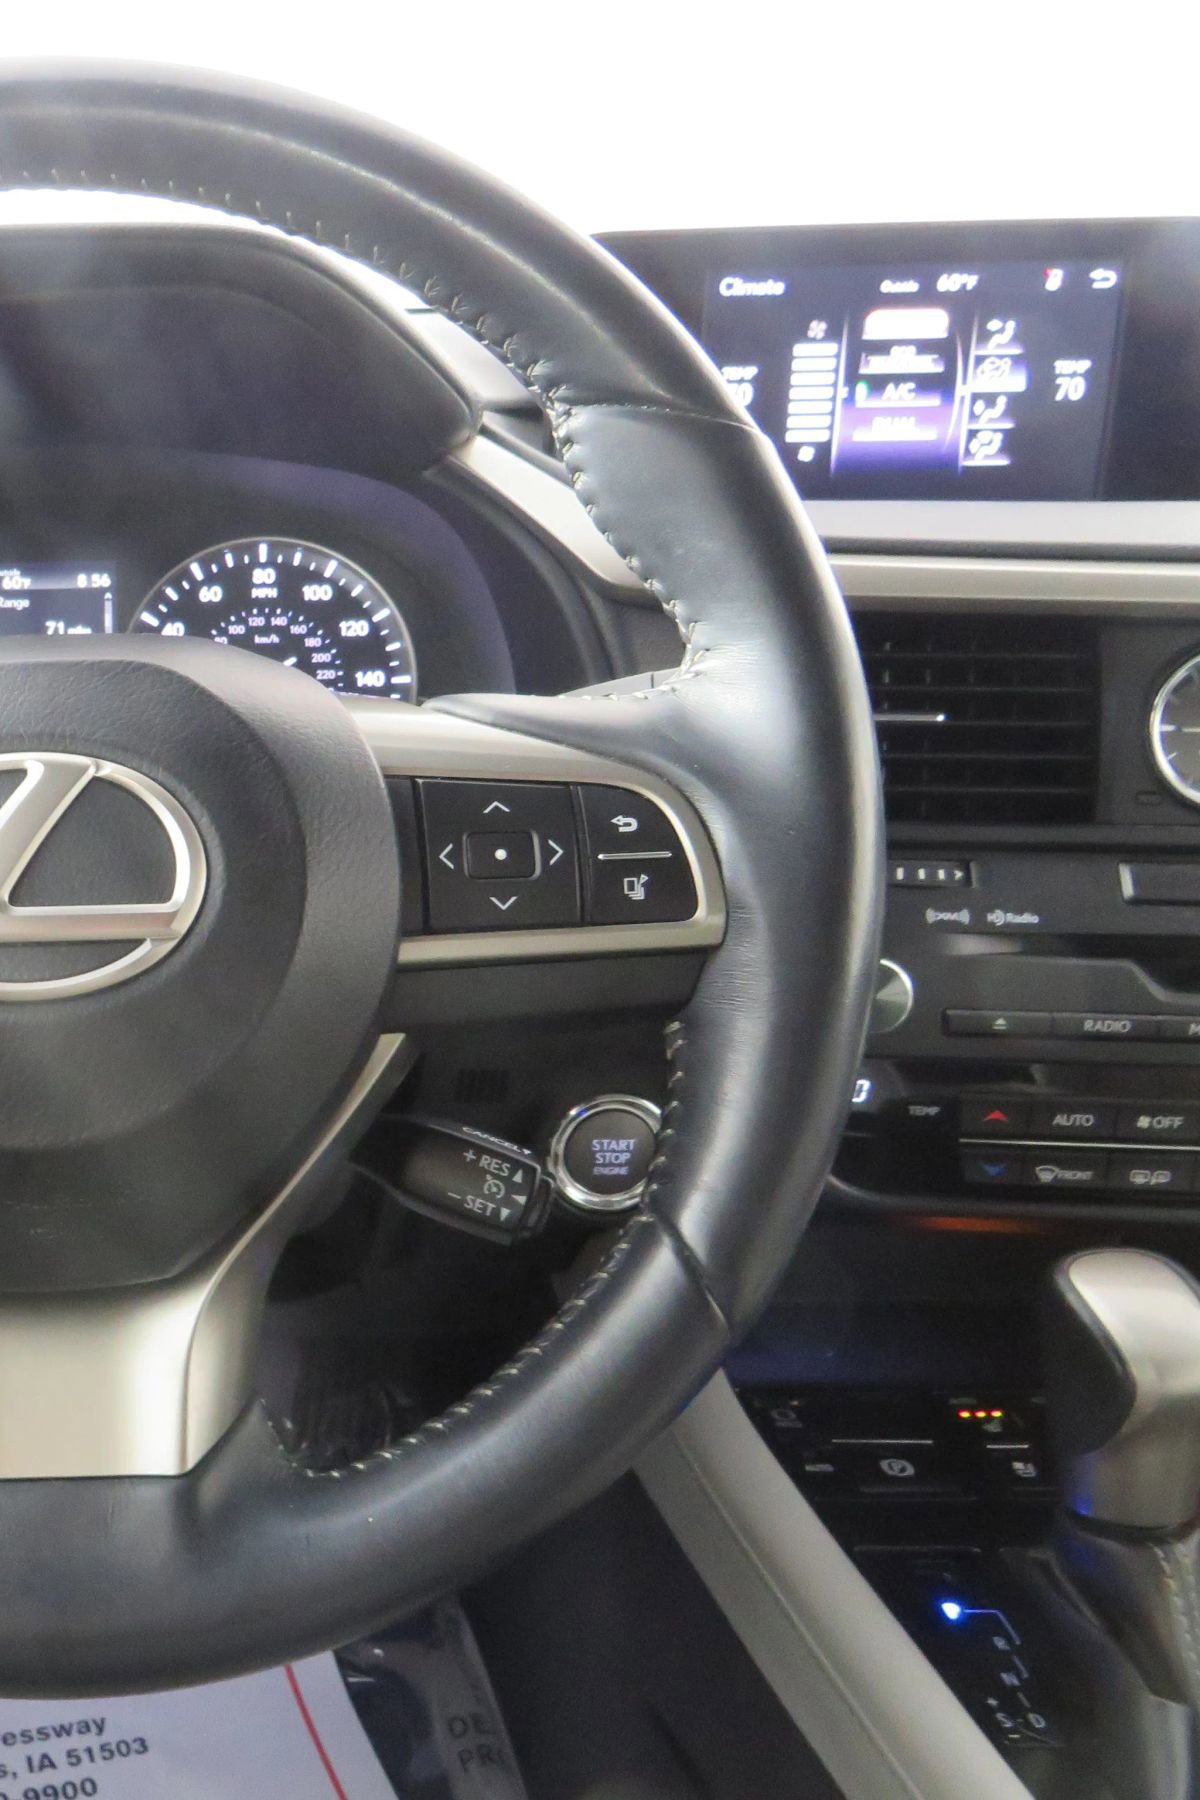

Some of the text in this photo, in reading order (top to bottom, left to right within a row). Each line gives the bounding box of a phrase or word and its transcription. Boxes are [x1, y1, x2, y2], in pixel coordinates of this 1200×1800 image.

[719, 276, 786, 296] Climate
[1053, 359, 1092, 375] TEMP
[881, 382, 916, 400] A/C
[1054, 376, 1086, 401] 70
[251, 567, 277, 585] 80
[198, 585, 224, 602] 60
[250, 587, 279, 599] MPH
[302, 584, 333, 601] 100
[45, 620, 65, 635] 71
[248, 616, 266, 627] 120
[270, 616, 288, 626] 140
[339, 619, 370, 637] 120
[161, 621, 186, 636] 40
[227, 624, 246, 635] 100
[289, 624, 308, 635] 160
[253, 634, 280, 644] km/h
[304, 637, 322, 648] 180
[311, 653, 332, 664] 200
[316, 669, 337, 680] 220
[355, 670, 386, 688] 140
[1083, 1019, 1132, 1033] RADIO
[908, 1105, 941, 1116] TEMP
[1052, 1113, 1095, 1127] AUTO
[1152, 1115, 1185, 1129] OFF
[462, 1127, 522, 1153] CANCEL
[592, 1139, 636, 1151] START
[595, 1152, 631, 1164] STOP
[479, 1154, 511, 1177] RES
[592, 1166, 629, 1175] ENGINE
[463, 1195, 497, 1217] SET
[26, 1752, 58, 1774] IA
[66, 1737, 149, 1768] 51503
